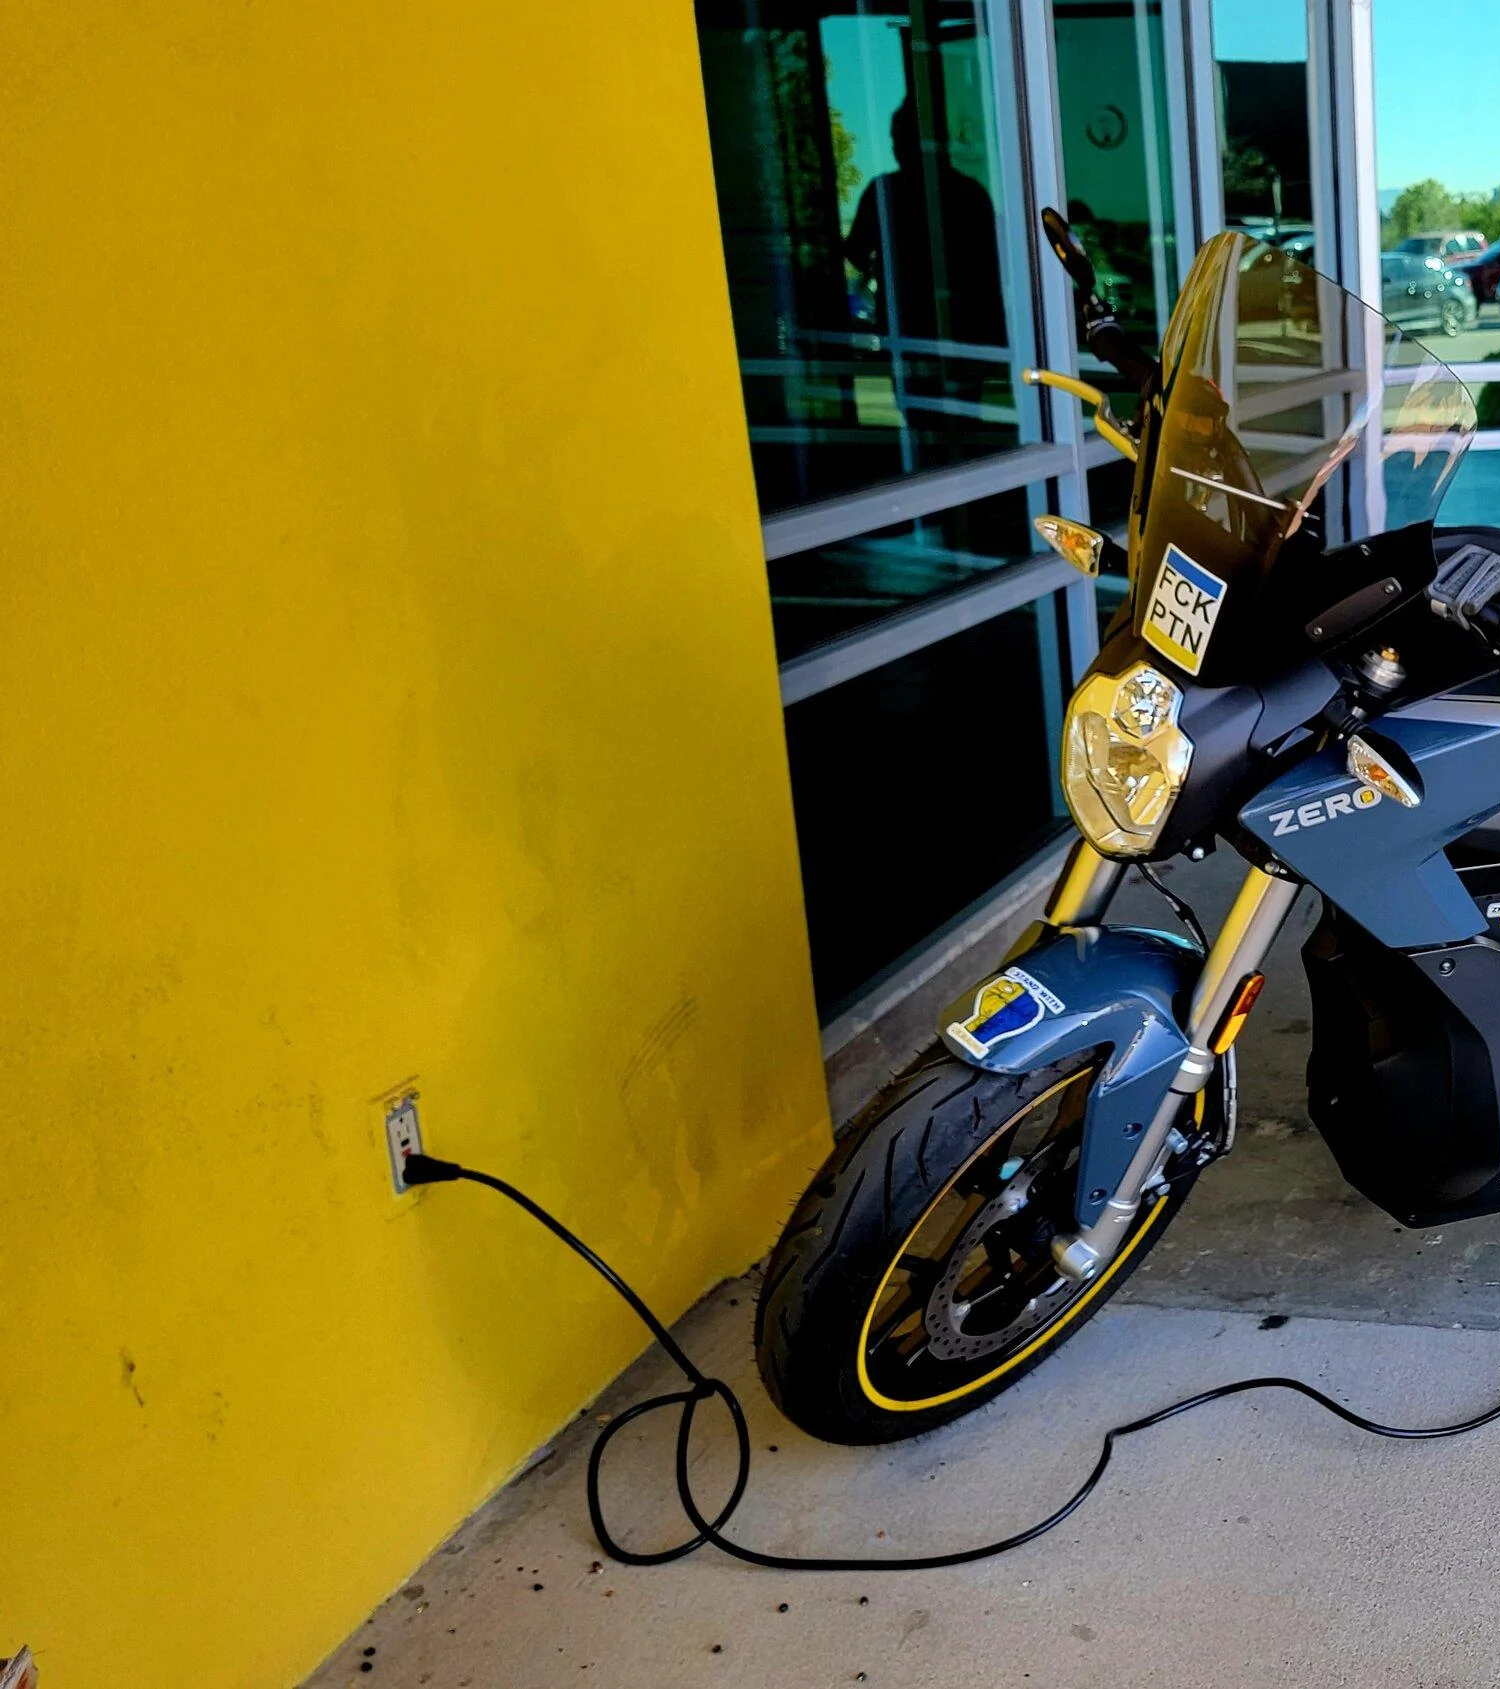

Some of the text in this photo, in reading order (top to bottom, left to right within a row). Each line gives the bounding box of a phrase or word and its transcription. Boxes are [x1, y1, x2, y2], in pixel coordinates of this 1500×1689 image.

[1159, 565, 1215, 625] FCK
[1150, 598, 1202, 655] PTN
[1268, 785, 1382, 837] ZERO
